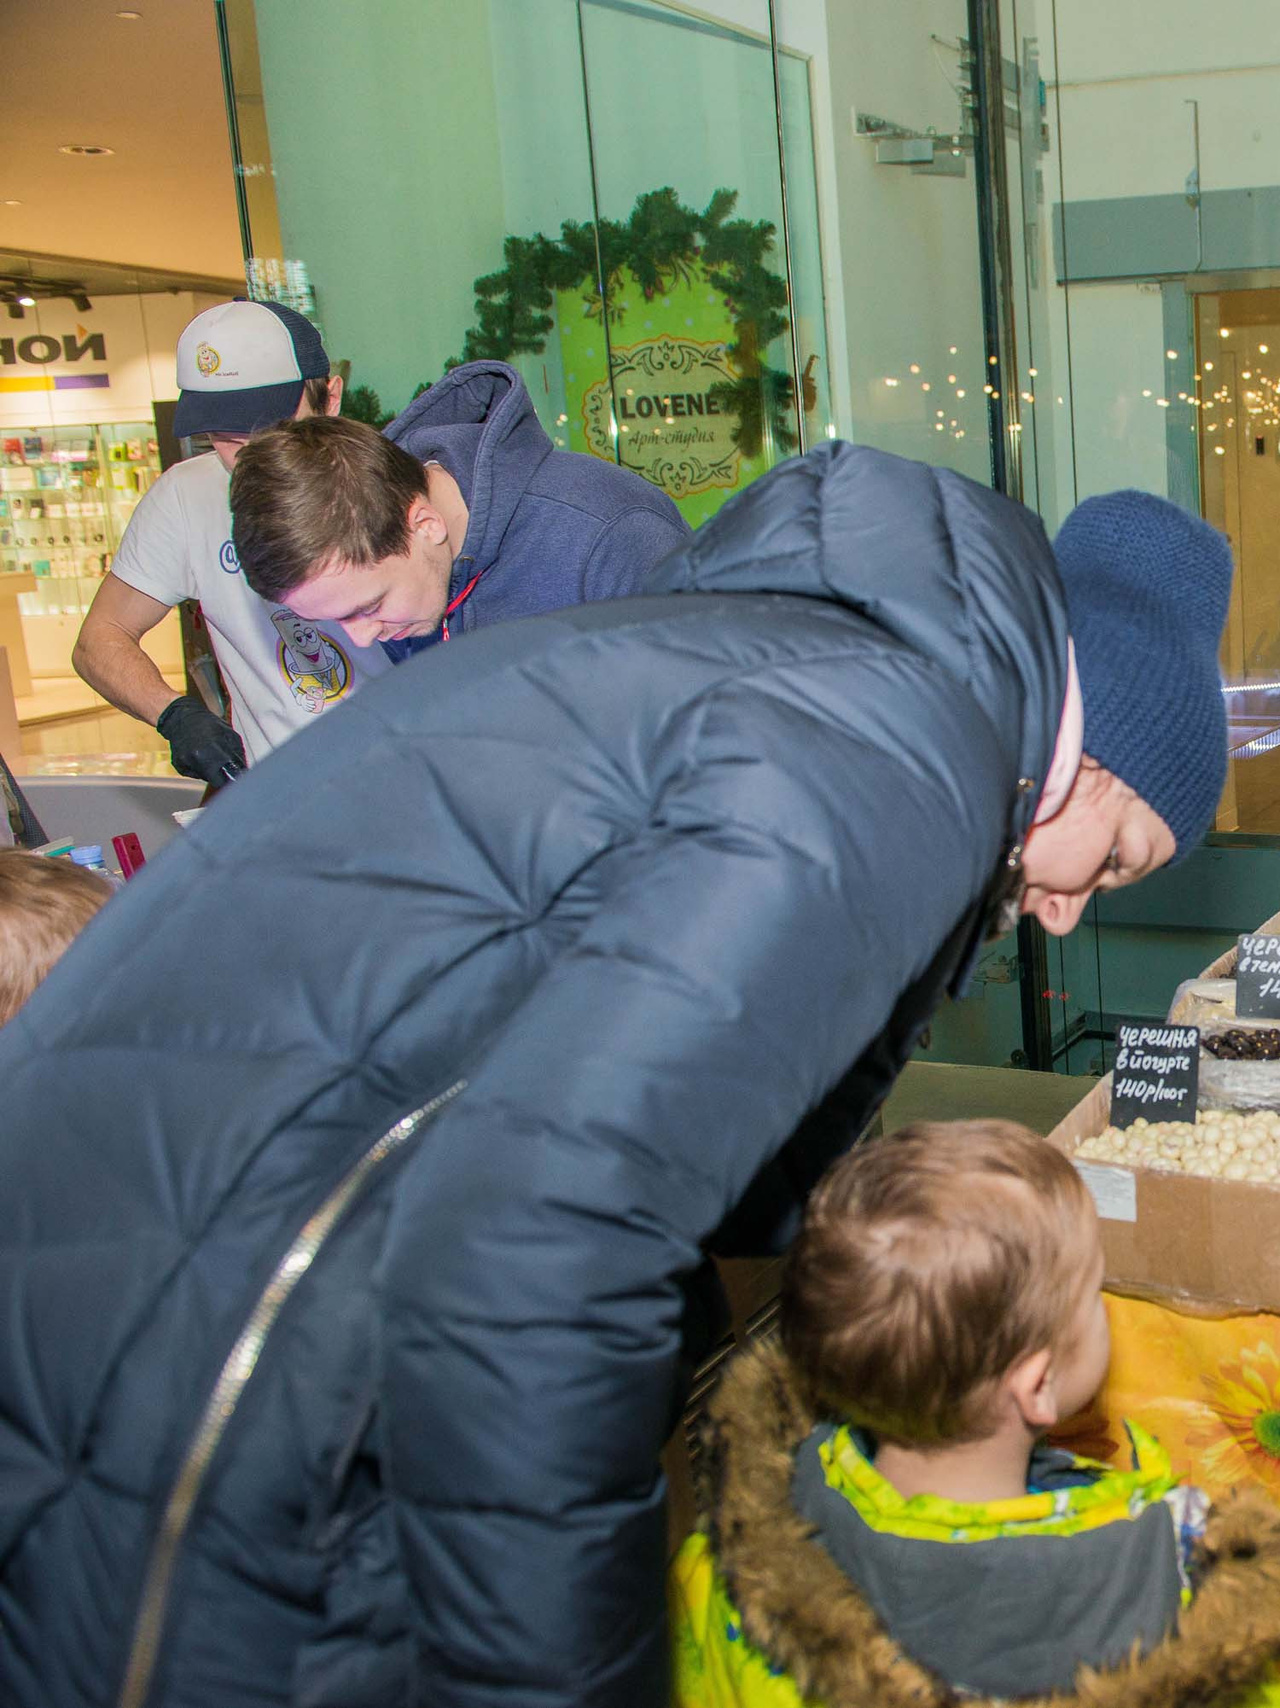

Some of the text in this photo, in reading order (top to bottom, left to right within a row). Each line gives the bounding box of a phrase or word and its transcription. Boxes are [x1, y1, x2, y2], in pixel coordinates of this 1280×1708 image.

[1120, 1025, 1198, 1048] ЧЕРЕШНЯ
[1116, 1047, 1190, 1074] в йогурте
